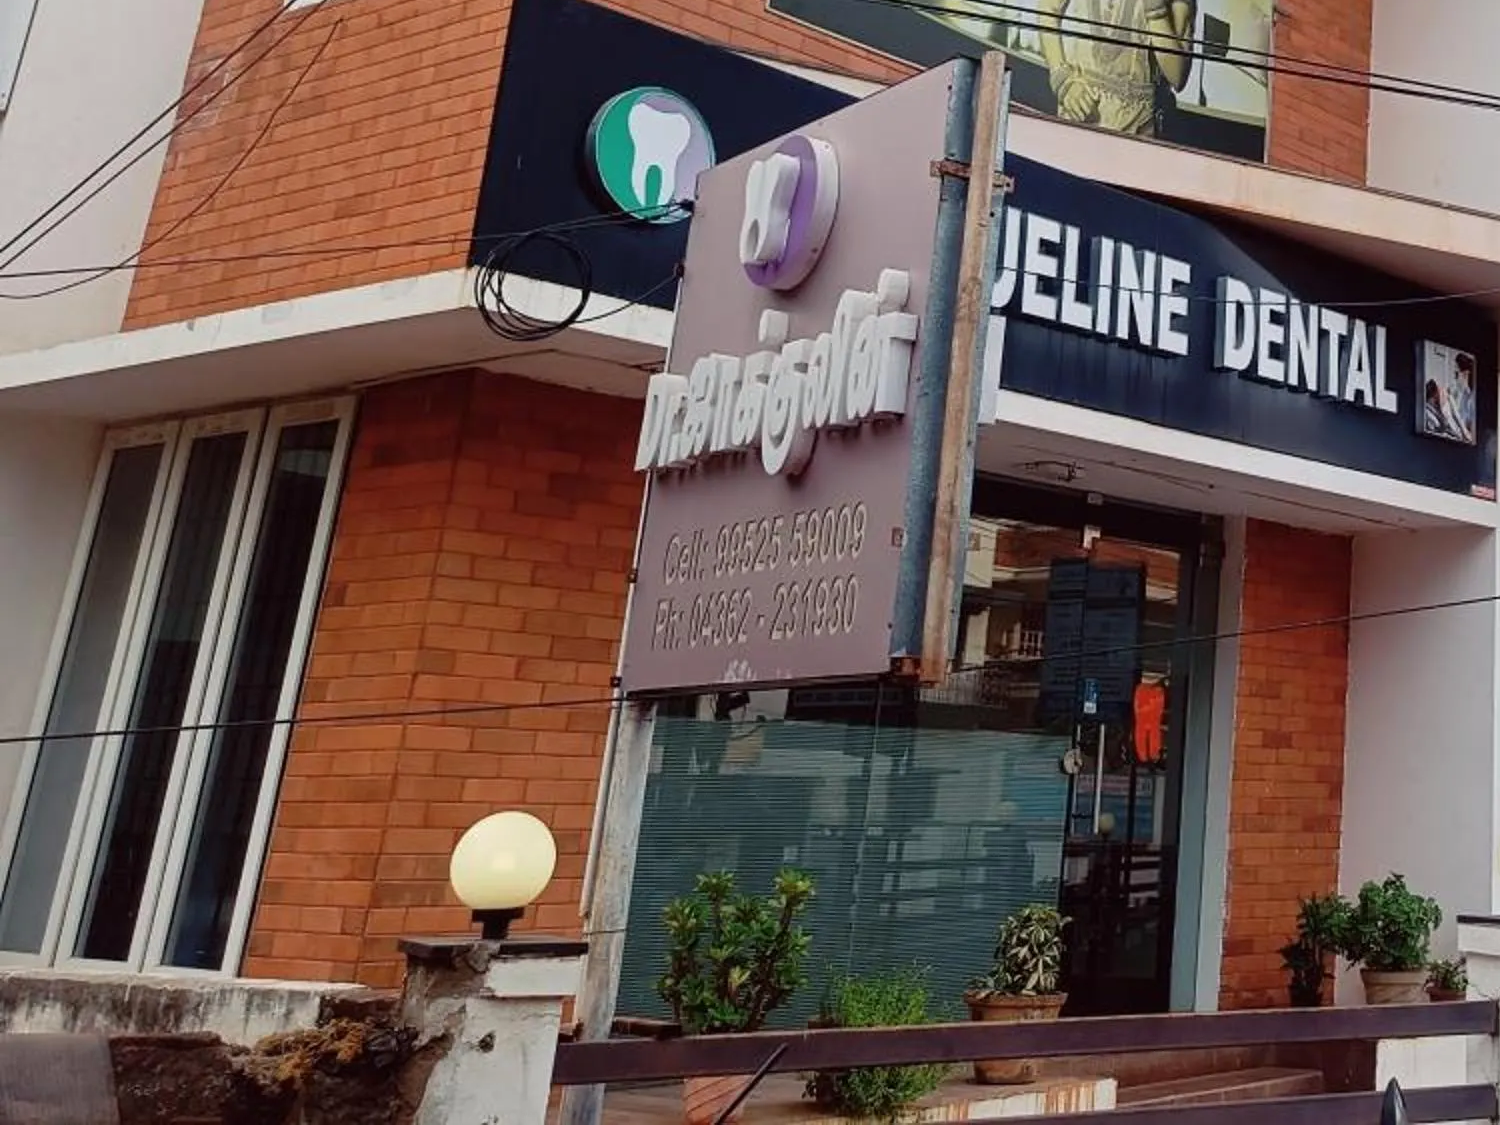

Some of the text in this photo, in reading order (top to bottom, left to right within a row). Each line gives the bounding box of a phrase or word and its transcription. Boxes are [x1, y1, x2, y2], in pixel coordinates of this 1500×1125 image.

[1216, 276, 1398, 413] DENTAL
[787, 501, 867, 568] 59009
[688, 587, 752, 649] 04362
[769, 572, 859, 641] 231930
